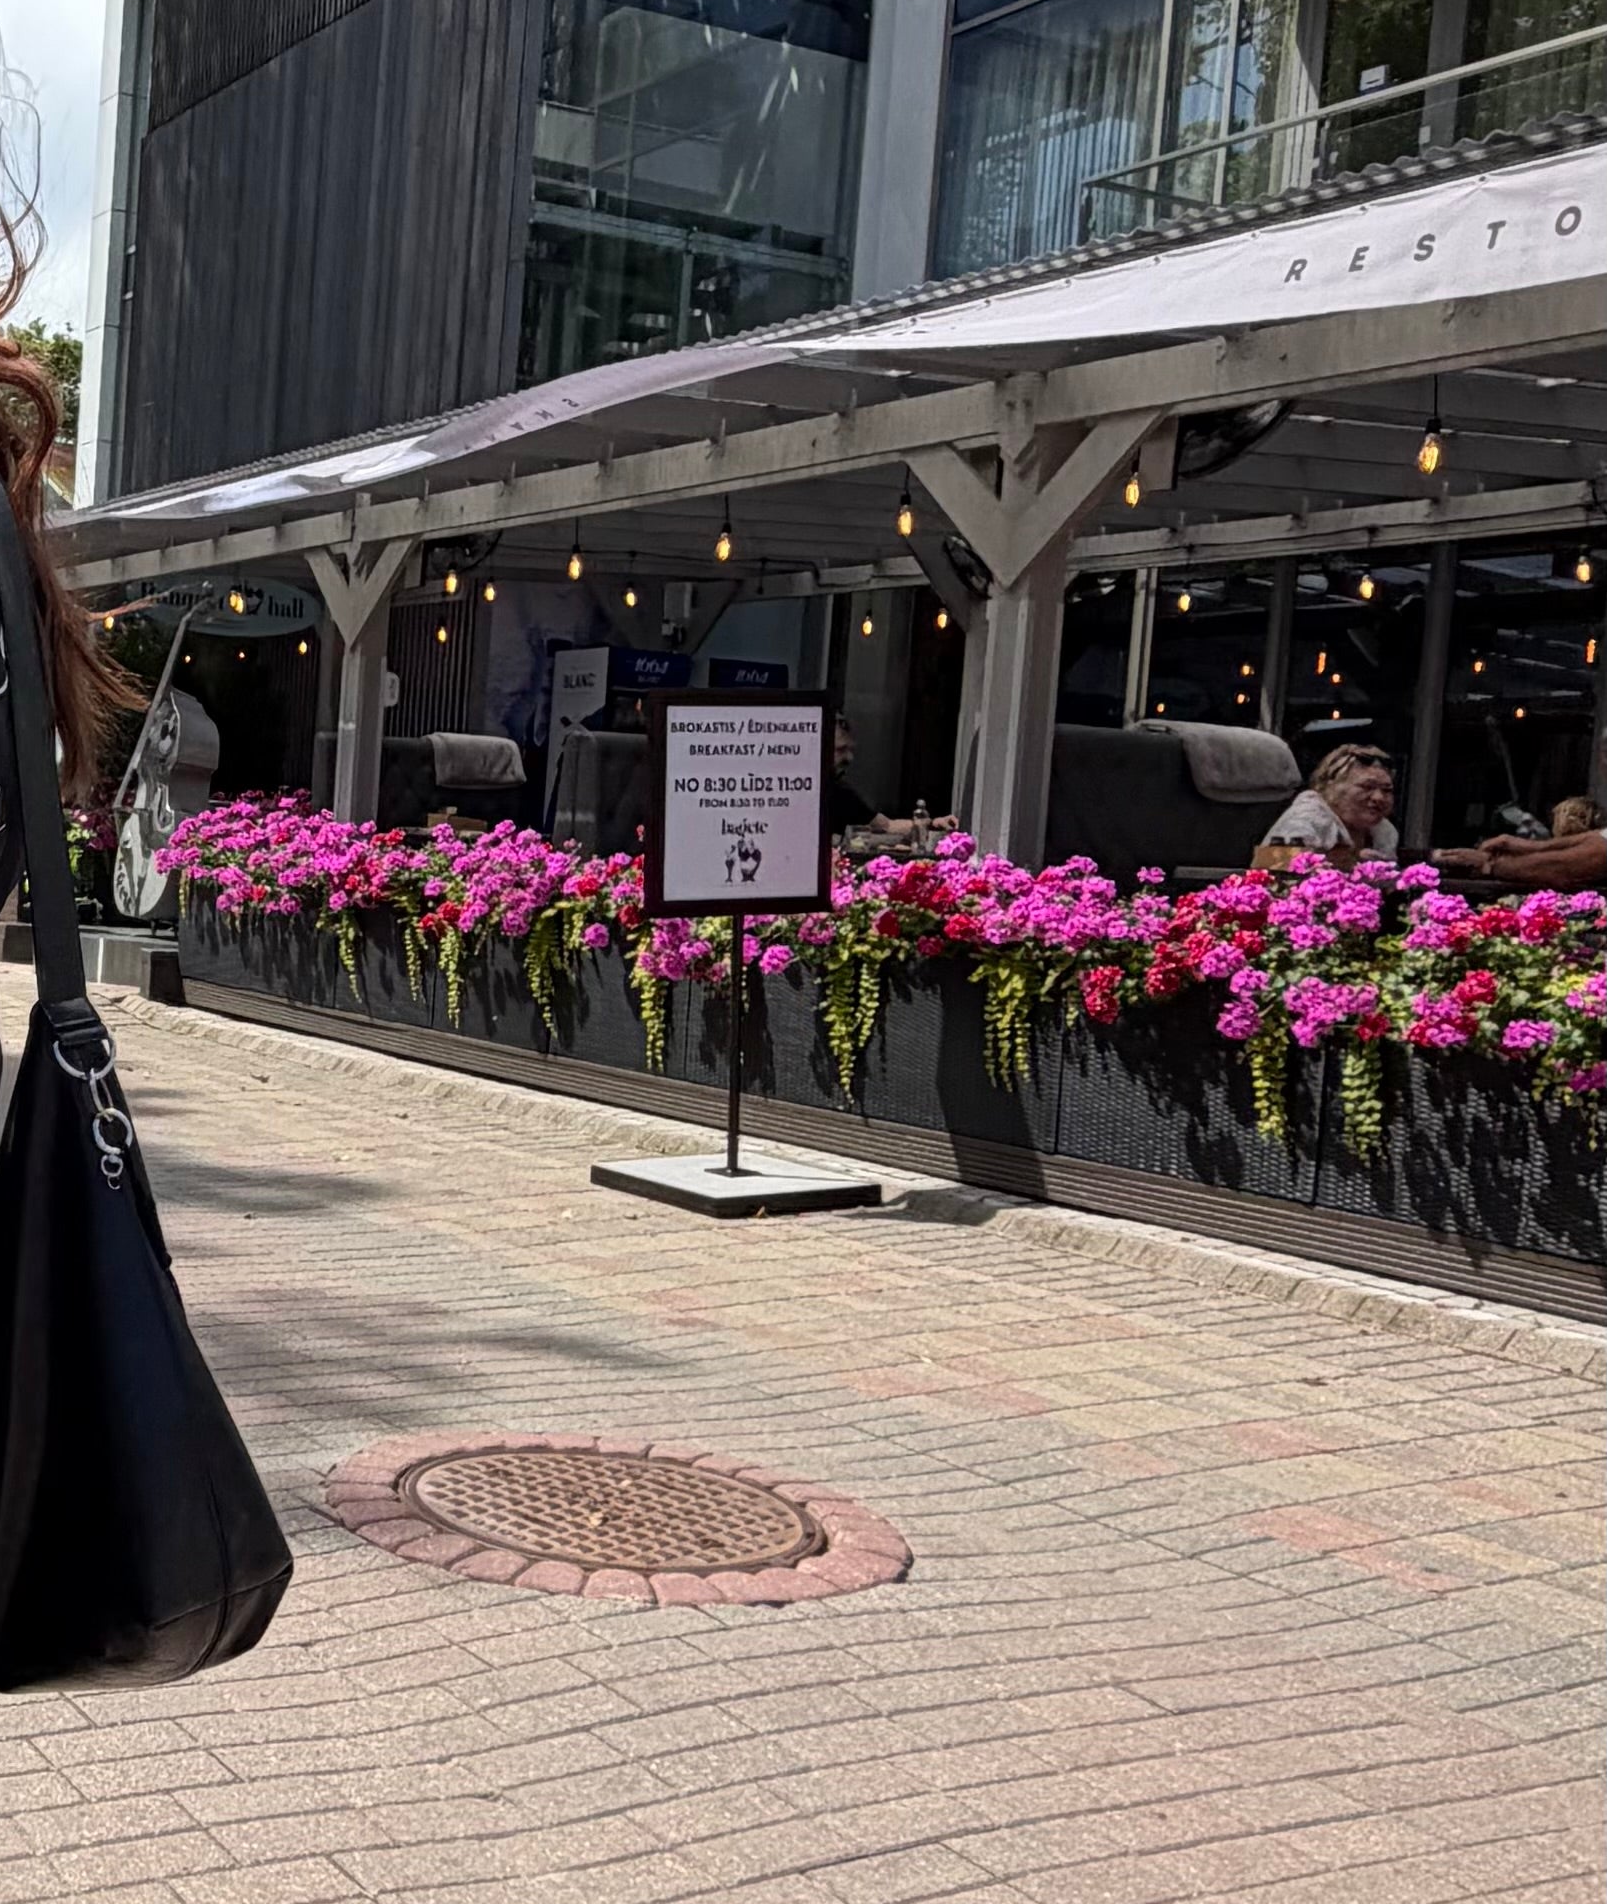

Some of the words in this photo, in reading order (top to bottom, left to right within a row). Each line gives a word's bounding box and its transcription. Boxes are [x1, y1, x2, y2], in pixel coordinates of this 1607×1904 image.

[1283, 205, 1582, 283] RESTO
[670, 721, 736, 734] BROKASTIS
[689, 744, 756, 756] BREAKFAST
[767, 744, 801, 756] MENU
[674, 777, 700, 793] NO
[703, 777, 737, 792] 8:30
[740, 772, 773, 792] LĪDZ
[777, 776, 813, 792] 11:00
